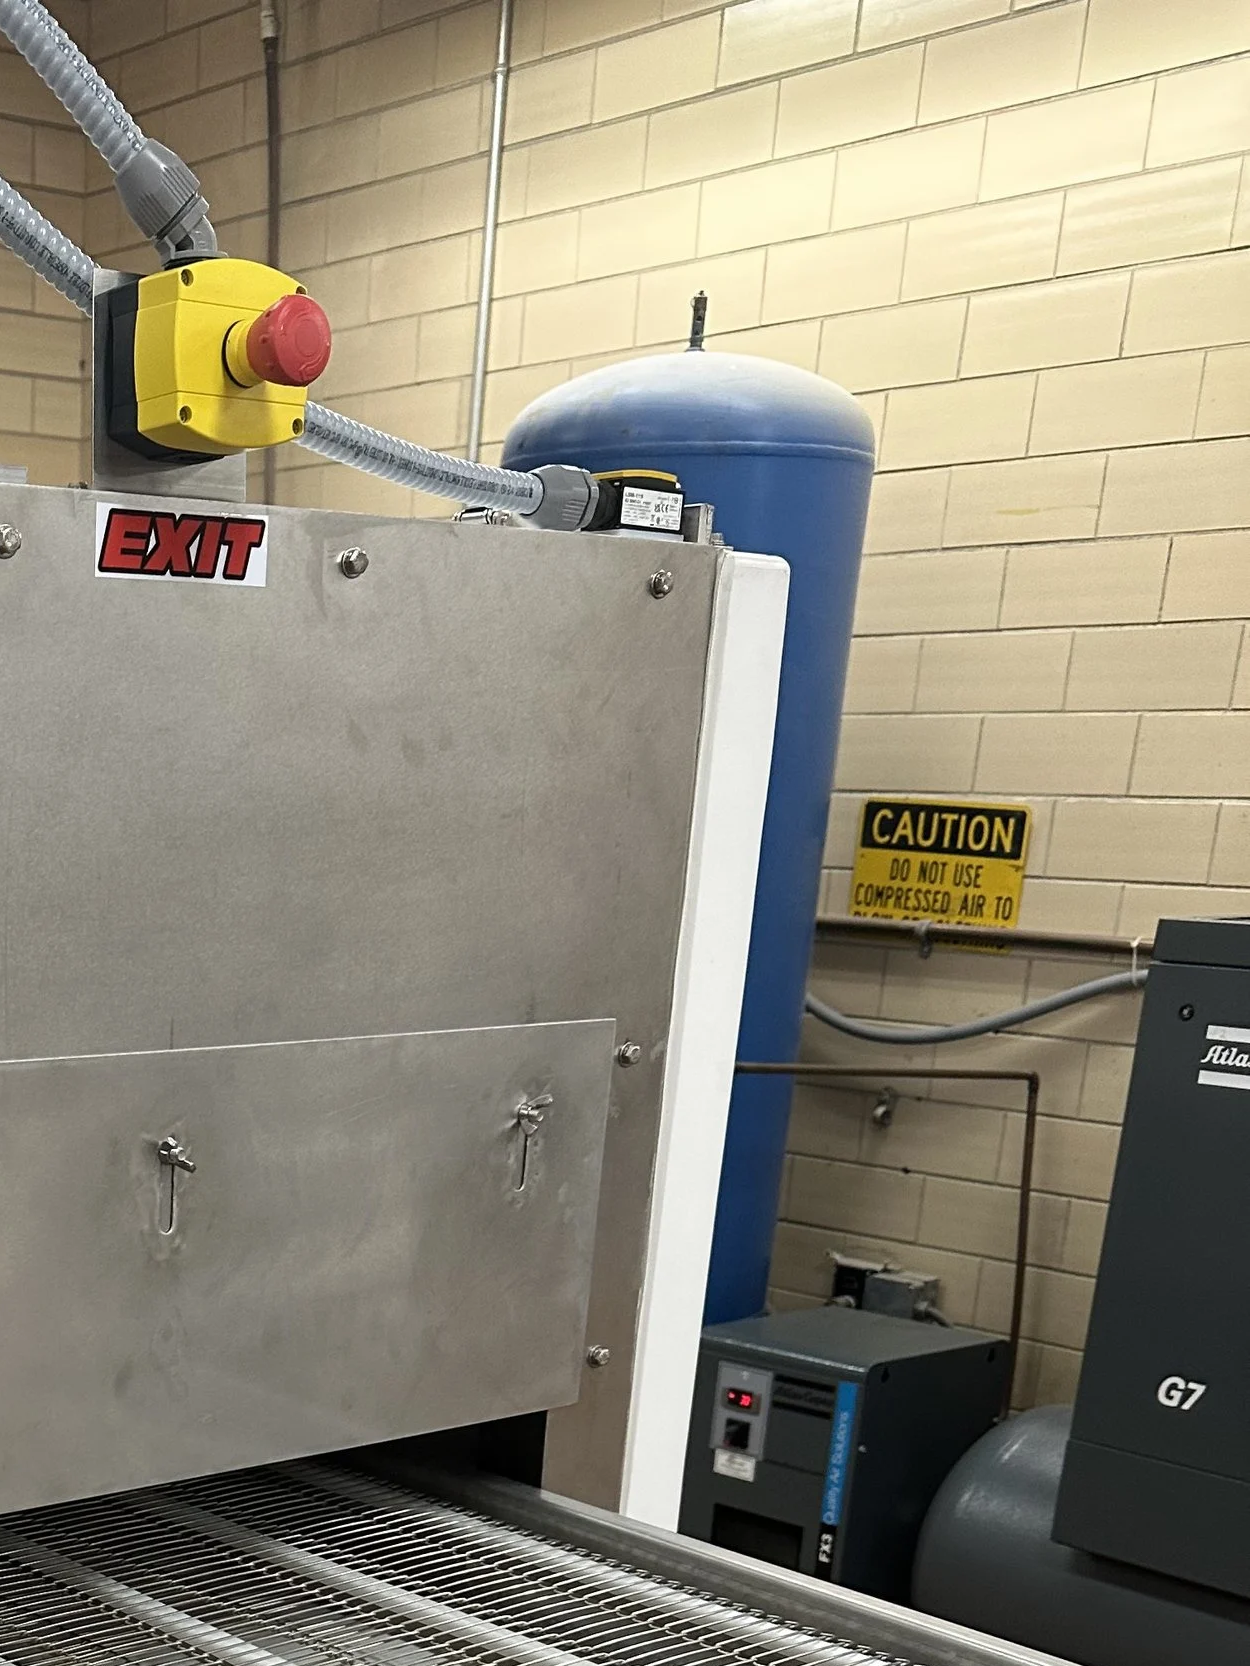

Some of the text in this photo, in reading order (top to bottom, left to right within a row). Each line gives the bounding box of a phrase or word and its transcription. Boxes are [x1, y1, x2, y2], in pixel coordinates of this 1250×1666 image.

[98, 508, 266, 580] EXIT
[872, 808, 1016, 853] CAUTION
[889, 858, 984, 889] DO NOT USE
[854, 883, 950, 915] COMPRESSED
[958, 893, 987, 918] AIR
[994, 896, 1013, 921] TO
[1200, 1045, 1250, 1067] Atla
[1158, 1376, 1206, 1410] G7
